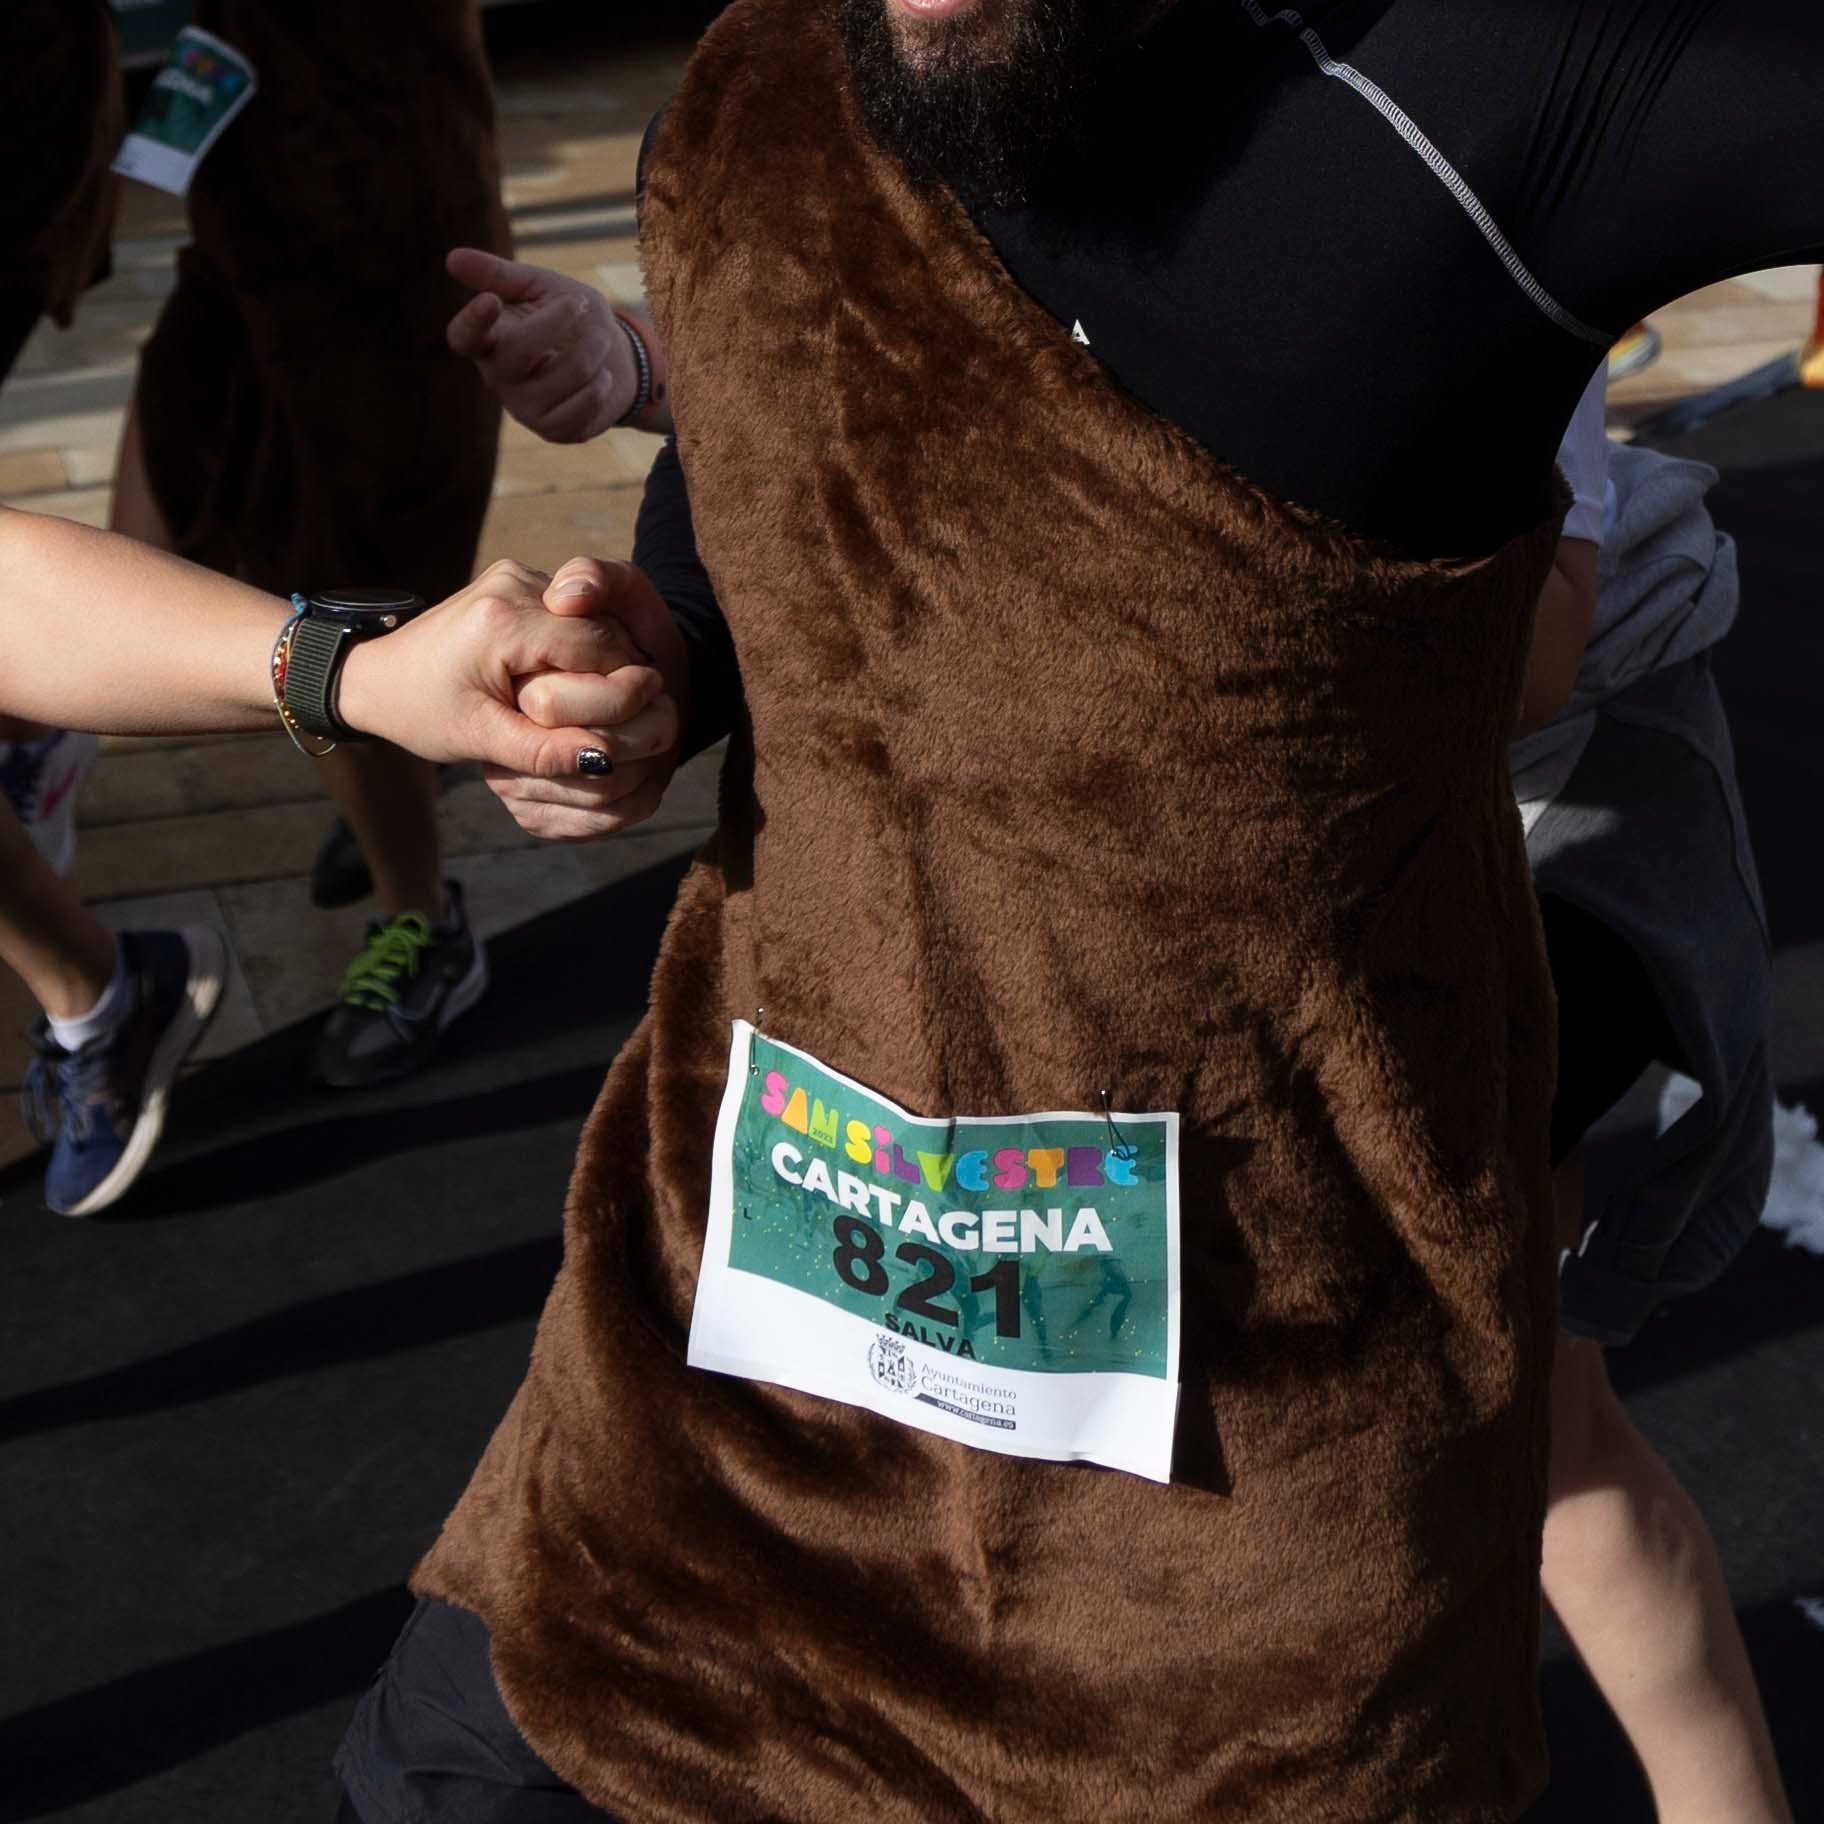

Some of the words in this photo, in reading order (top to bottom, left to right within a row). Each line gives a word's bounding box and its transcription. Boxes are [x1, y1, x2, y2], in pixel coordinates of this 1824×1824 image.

[761, 1071, 839, 1149] SAN
[771, 1142, 1113, 1253] CARTAGENA
[832, 1214, 1021, 1339] 821
[884, 1311, 977, 1361] SALVA
[920, 1363, 1017, 1400] Ayuntamiento
[920, 1376, 1017, 1415] Cartagena
